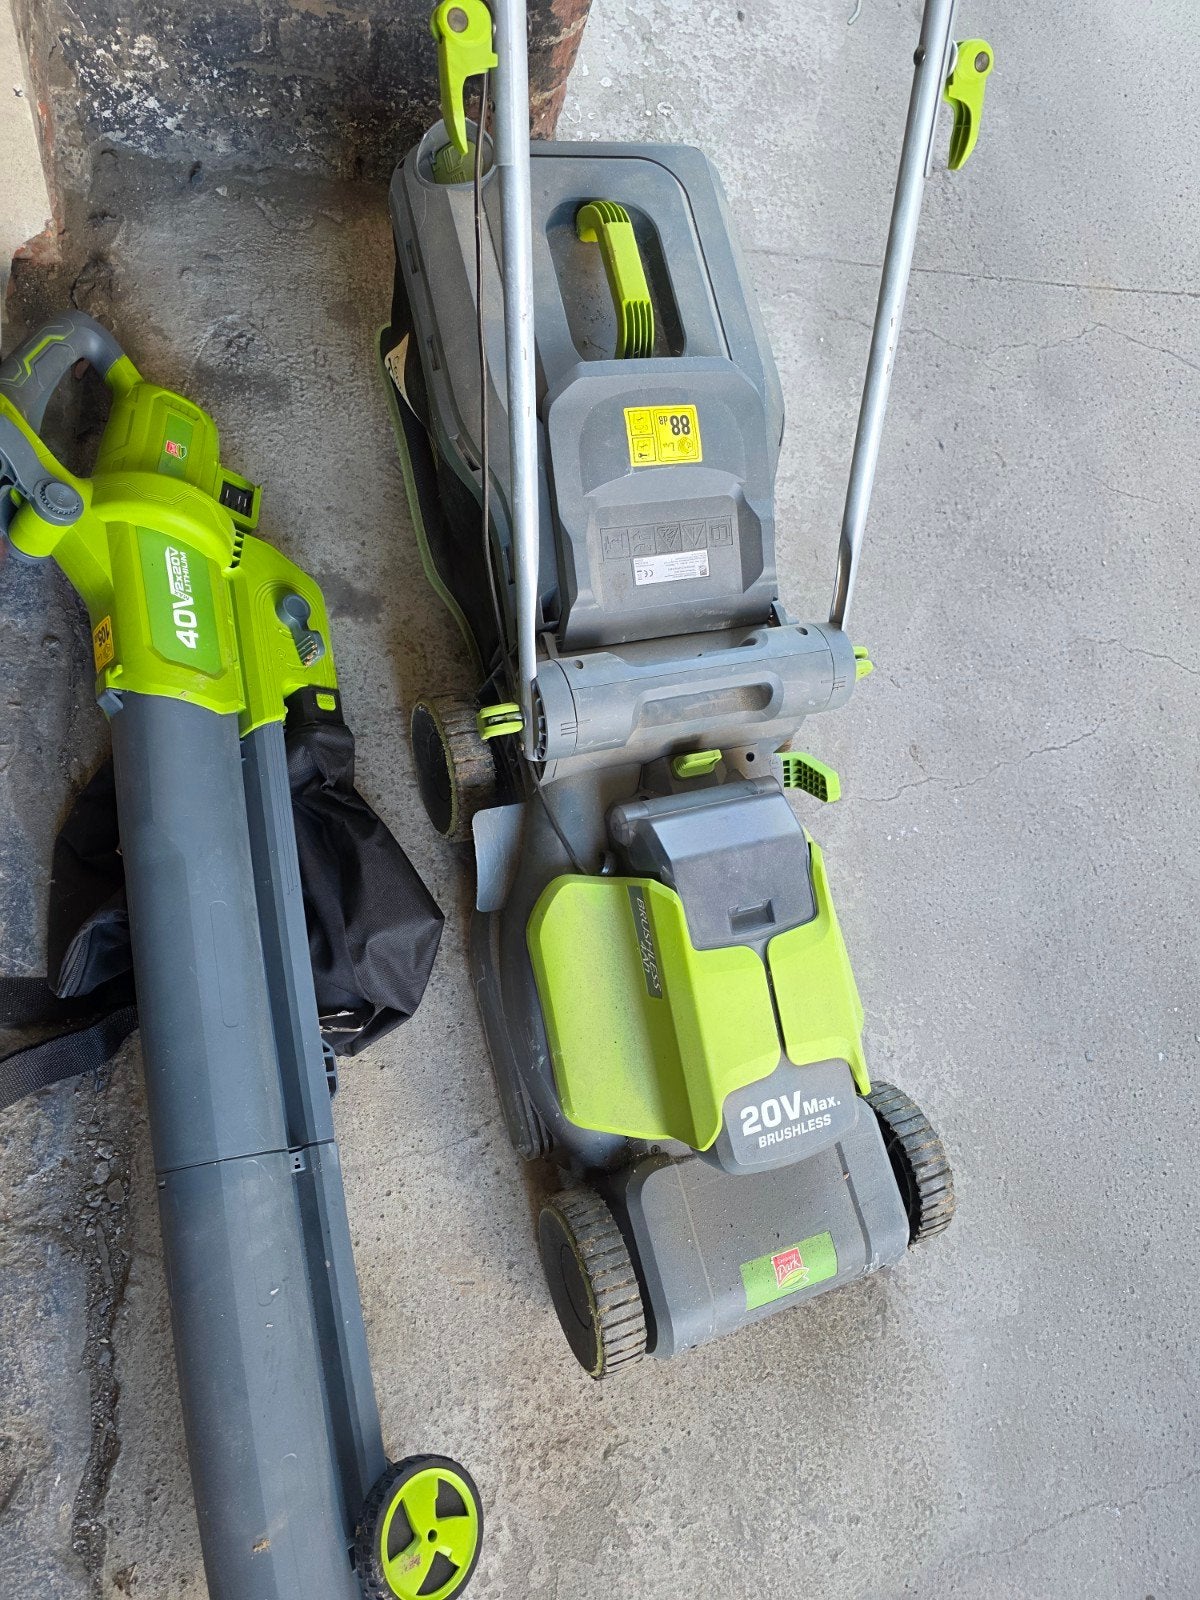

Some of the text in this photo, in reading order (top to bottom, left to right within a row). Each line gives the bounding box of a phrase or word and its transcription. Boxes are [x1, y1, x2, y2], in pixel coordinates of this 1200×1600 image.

[670, 415, 690, 435] 88
[180, 551, 192, 593] LITHIUM
[171, 591, 199, 649] 40V
[637, 897, 662, 992] BRUSHLESS
[740, 1090, 841, 1137] 20V Max.
[758, 1113, 832, 1149] BRUSHLESS
